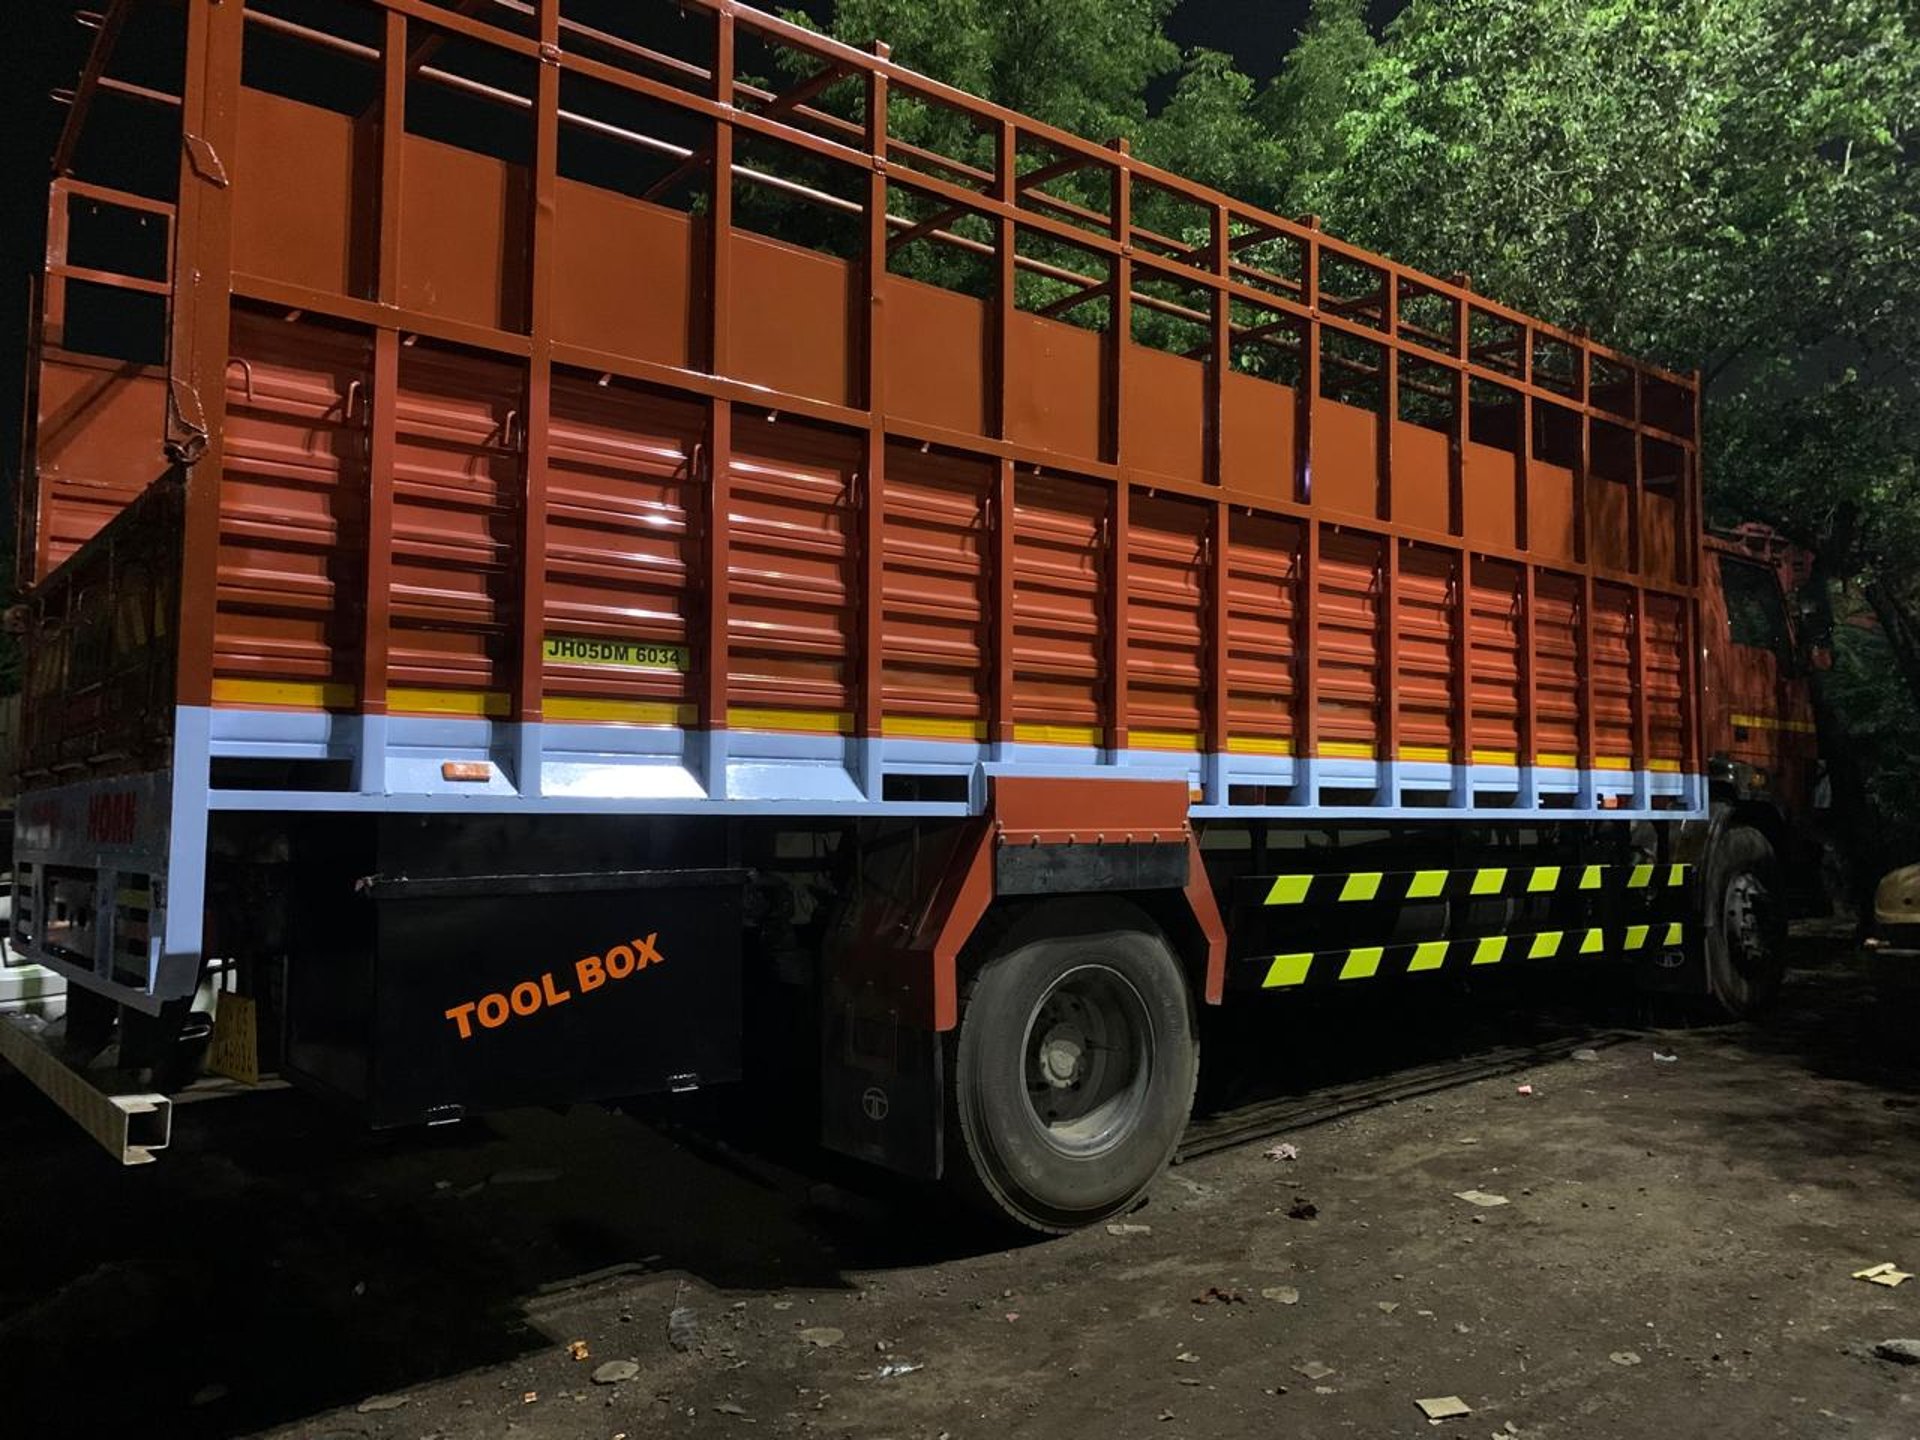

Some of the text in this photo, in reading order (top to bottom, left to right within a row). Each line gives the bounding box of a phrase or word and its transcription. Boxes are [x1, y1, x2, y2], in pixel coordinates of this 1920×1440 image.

[548, 640, 681, 665] JH05DM 6034
[445, 932, 665, 1039] TOOL BOX
